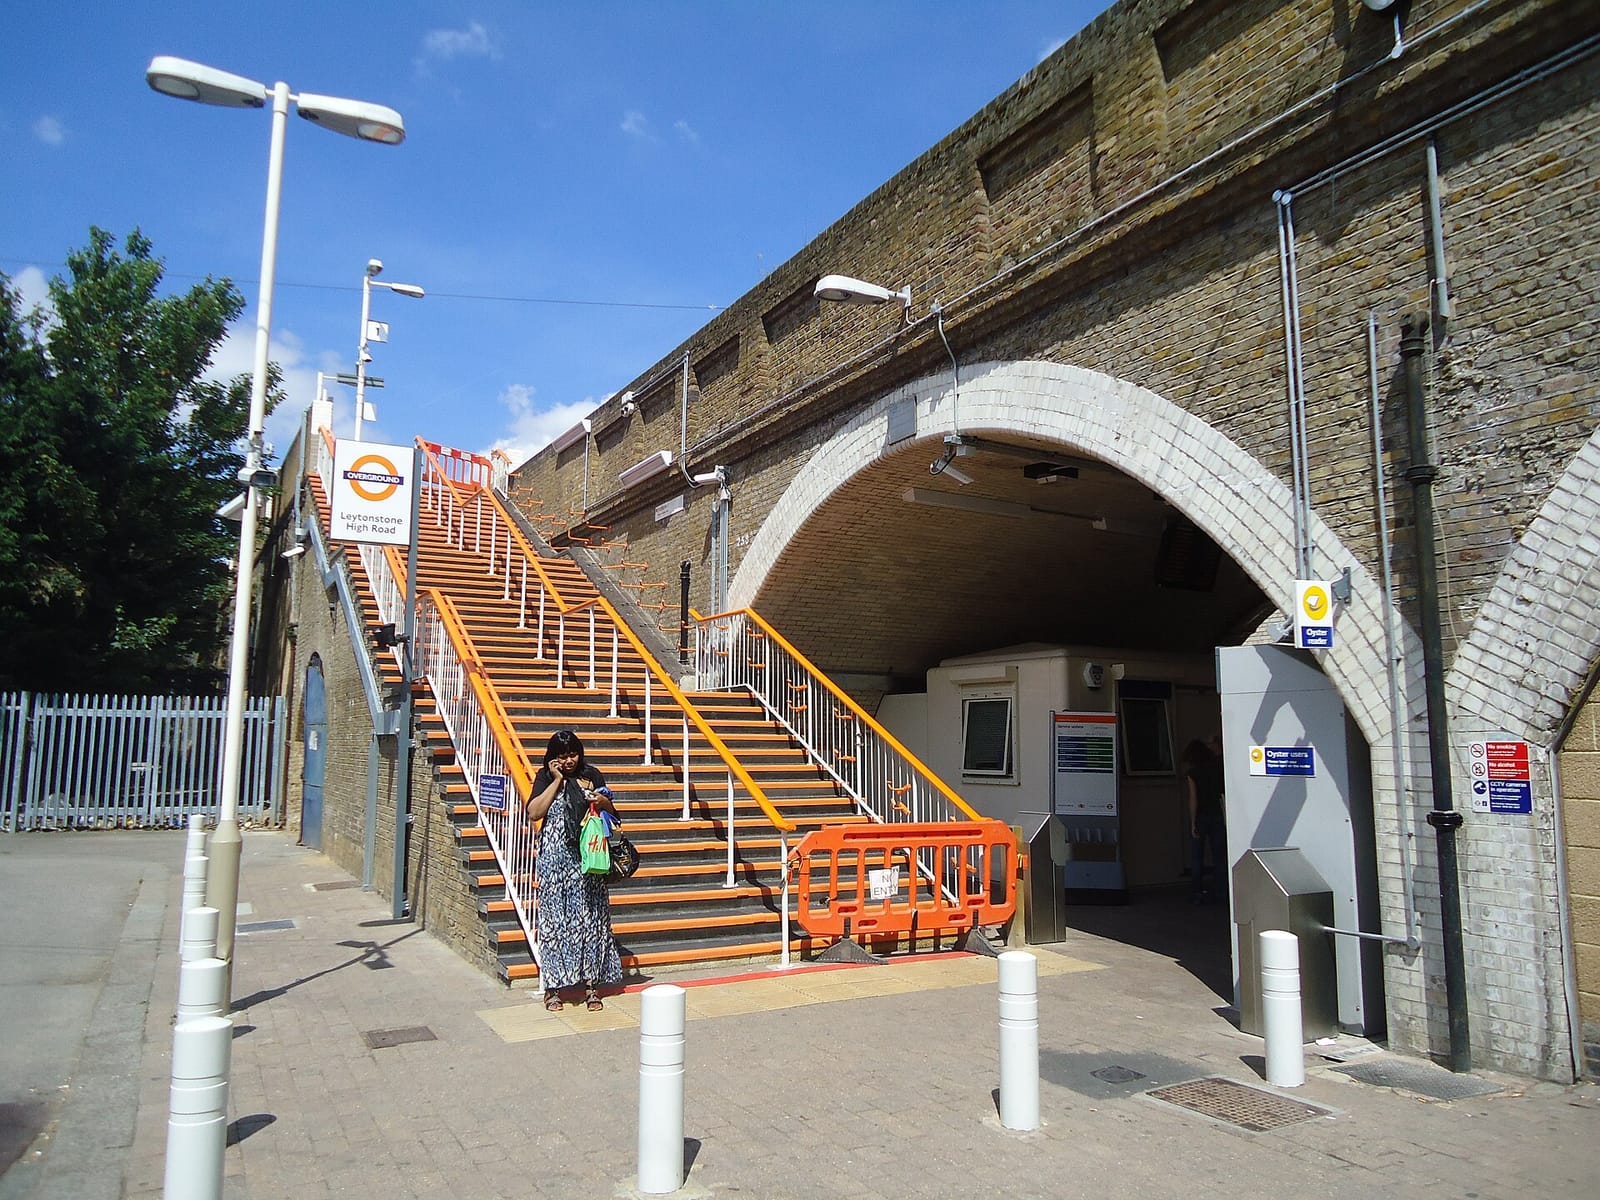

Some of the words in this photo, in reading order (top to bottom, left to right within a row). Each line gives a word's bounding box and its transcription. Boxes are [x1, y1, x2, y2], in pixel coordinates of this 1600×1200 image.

[347, 471, 400, 483] OVERGROUND
[340, 511, 403, 525] Leytonstone
[346, 522, 369, 533] High
[371, 524, 396, 534] Road
[1306, 628, 1328, 637] Oyster
[1266, 750, 1289, 758] Oyster
